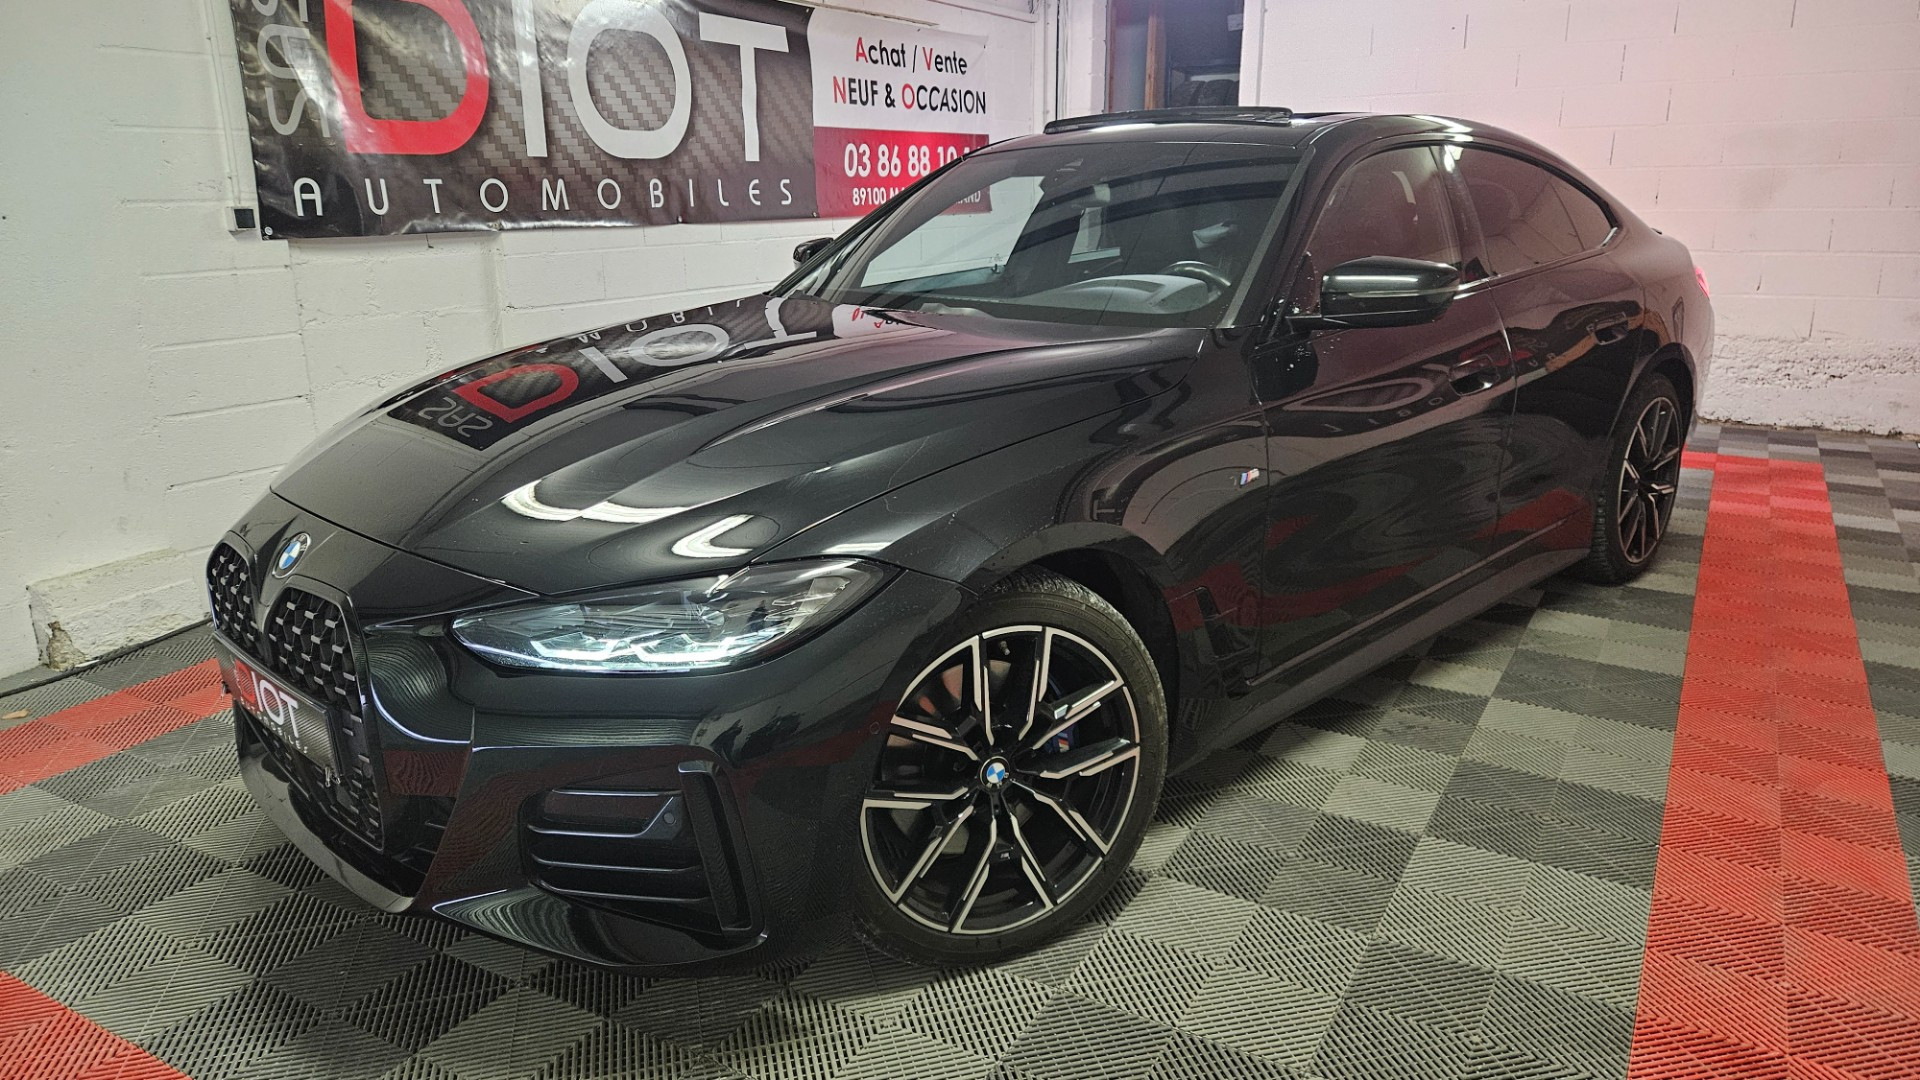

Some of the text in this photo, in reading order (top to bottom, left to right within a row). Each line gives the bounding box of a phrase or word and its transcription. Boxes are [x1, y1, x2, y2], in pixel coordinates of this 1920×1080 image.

[855, 36, 907, 69] Achat
[922, 46, 968, 75] Vente
[324, 0, 789, 162] DIOT
[832, 75, 987, 116] NEUF & OCCASION
[844, 143, 871, 178] 03
[877, 144, 902, 178] 86
[907, 144, 931, 178] 88
[292, 177, 794, 217] AUTOMOBILES
[852, 187, 887, 207] 89100
[234, 658, 299, 739] DIOT
